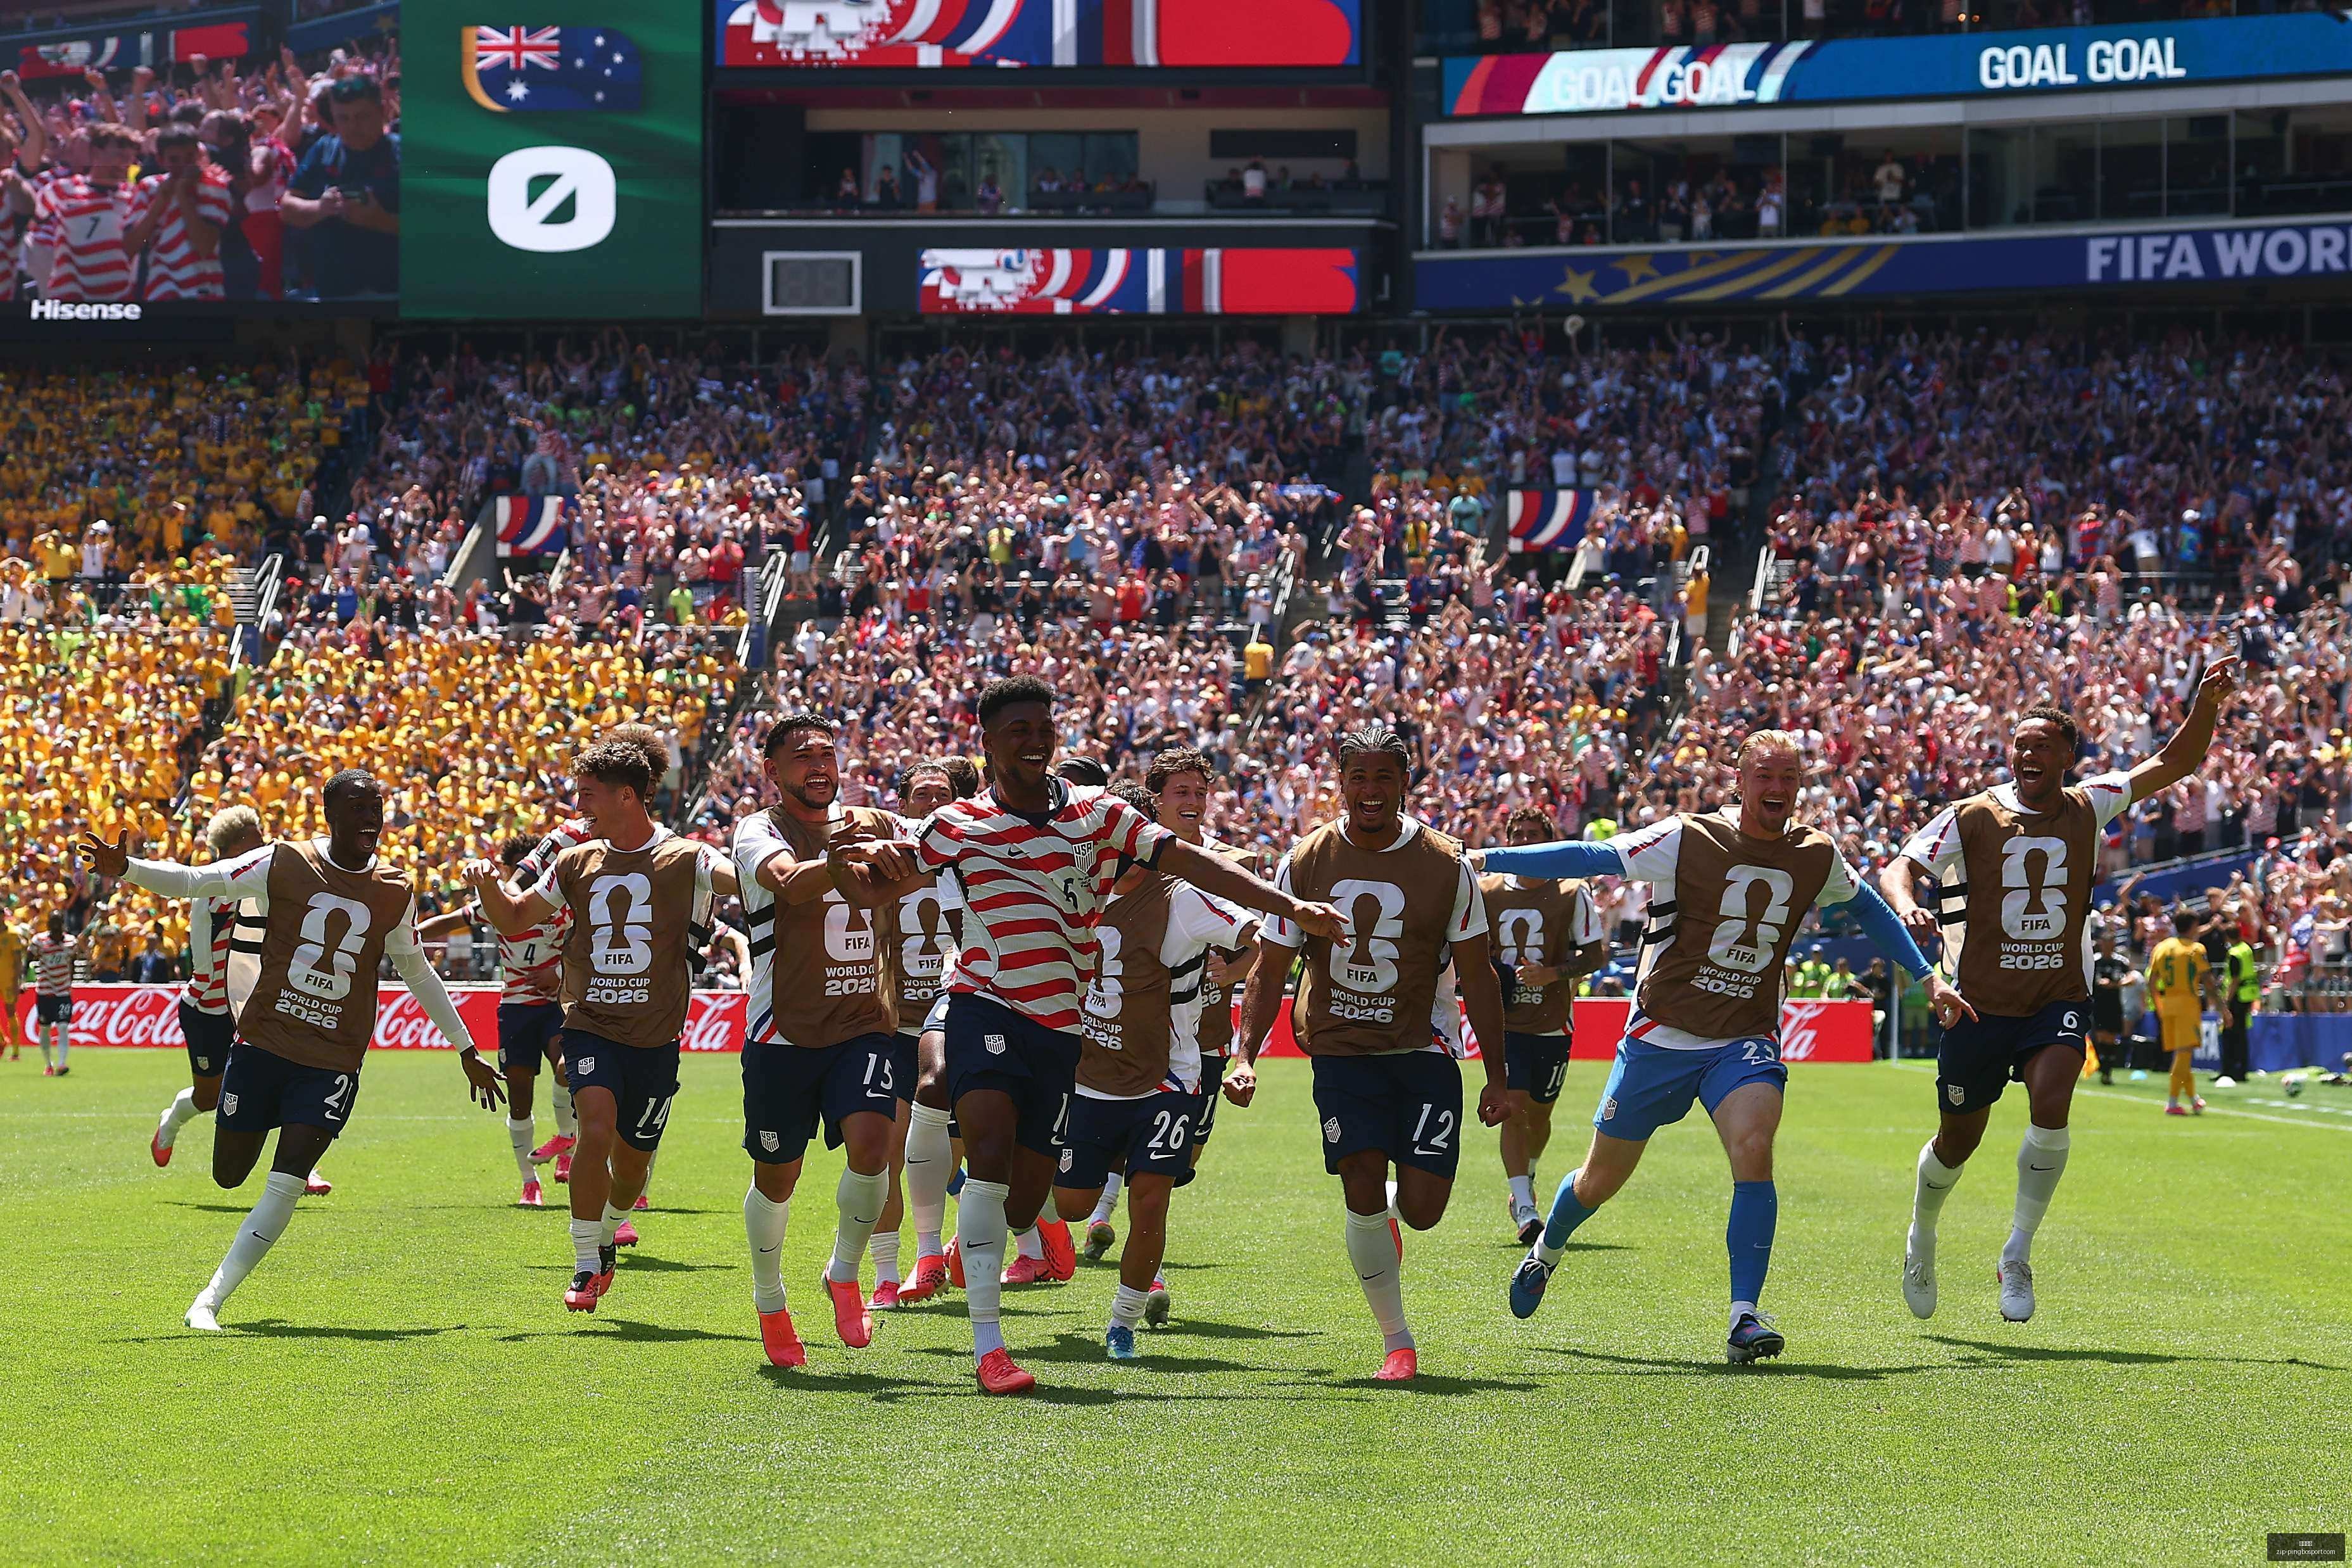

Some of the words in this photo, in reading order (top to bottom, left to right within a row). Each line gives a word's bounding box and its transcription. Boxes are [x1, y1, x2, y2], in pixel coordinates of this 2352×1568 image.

[1980, 43, 2078, 89] GOAL
[2087, 37, 2187, 83] GOAL
[1553, 63, 1644, 106] GOAL
[1660, 60, 1756, 104] GOAL
[488, 146, 616, 252] 0
[86, 216, 100, 239] 7
[2087, 233, 2205, 281] FIFA
[2213, 227, 2351, 277] WOR
[30, 298, 142, 320] Hisense
[1073, 842, 1092, 856] USA
[2021, 920, 2051, 930] FIFA
[845, 937, 870, 950] FIFA
[2001, 942, 2042, 952] WORLD
[2044, 943, 2064, 952] CUP
[524, 944, 536, 965] 4
[605, 954, 634, 964] FIFA
[1726, 949, 1755, 964] FIFA
[2000, 954, 2064, 970] 2026
[825, 966, 867, 977] WORLD
[1347, 968, 1378, 982] FIFA
[1699, 965, 1740, 982] WORLD
[305, 973, 334, 991] FIFA
[628, 978, 650, 987] CUP
[1690, 976, 1754, 999] 2026
[280, 989, 320, 1008] WORLD
[321, 1003, 343, 1014] CUP
[586, 988, 649, 1004] 2026
[904, 988, 934, 1001] 20
[1090, 994, 1106, 1008] FIFA
[1202, 989, 1222, 1008] 26
[1331, 988, 1369, 1006] WORLD
[1371, 997, 1396, 1006] CUP
[1512, 993, 1543, 1004] 026
[275, 999, 338, 1029] 2026
[1329, 1000, 1393, 1023] 2026
[2063, 1011, 2079, 1028] 6
[1082, 1015, 1102, 1028] ORLD
[1103, 1022, 1122, 1034] CUP
[985, 1035, 1003, 1044] USA
[1082, 1024, 1122, 1050] 026
[863, 1053, 893, 1090] 15
[1546, 1062, 1567, 1089] 10
[225, 1094, 237, 1103] USA
[1949, 1085, 1963, 1095] USA
[636, 1096, 671, 1130] 14
[1148, 1110, 1189, 1149] 26
[1325, 1118, 1337, 1131] USA
[1412, 1104, 1453, 1149] 12
[761, 1131, 776, 1141] USA
